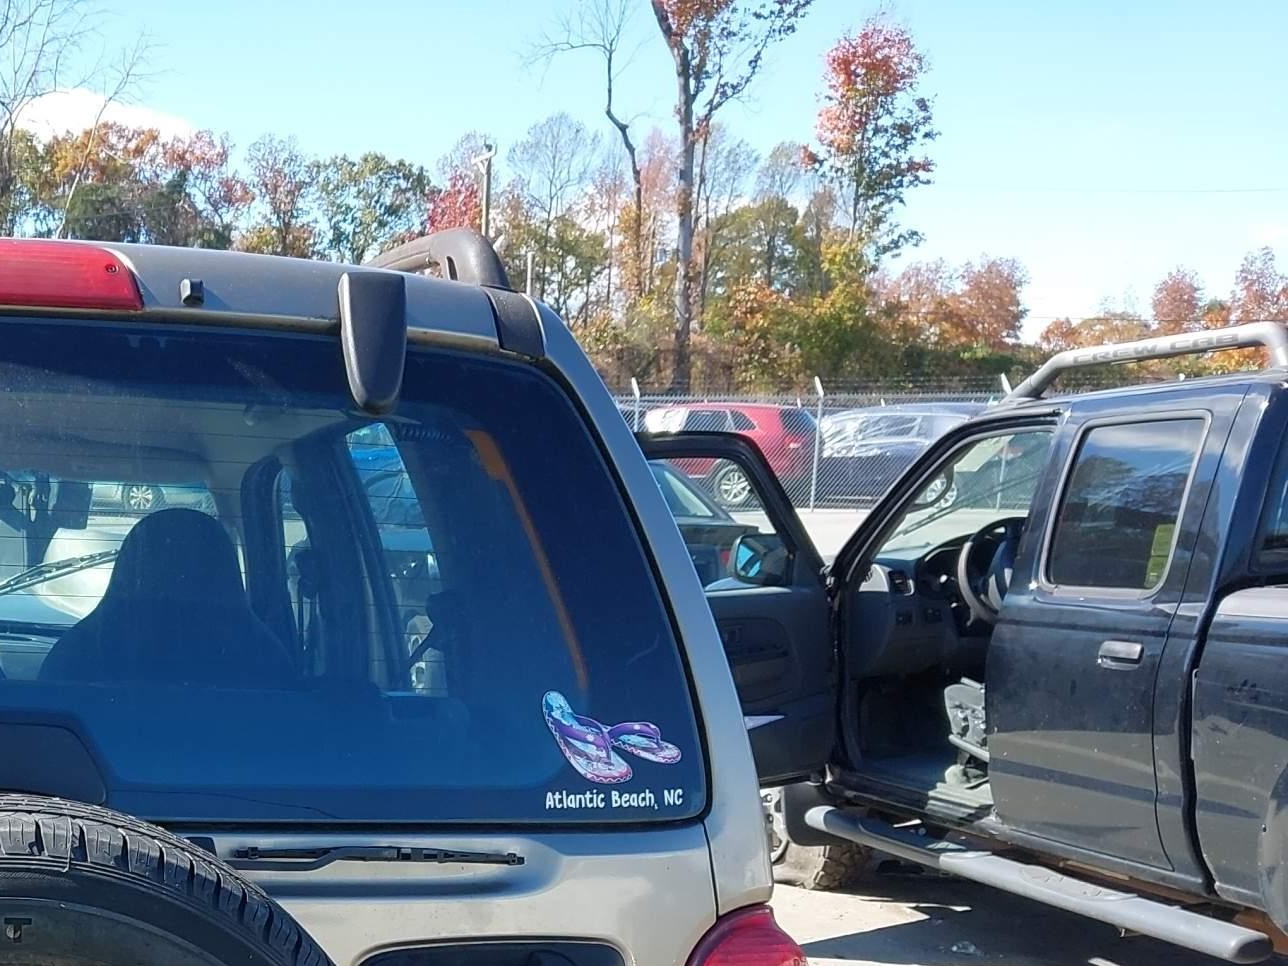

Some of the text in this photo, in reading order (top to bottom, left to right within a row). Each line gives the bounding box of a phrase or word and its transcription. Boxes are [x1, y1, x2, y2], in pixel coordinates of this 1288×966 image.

[1072, 344, 1158, 364] CREW
[545, 788, 684, 810] Atlantic Beach, NC
